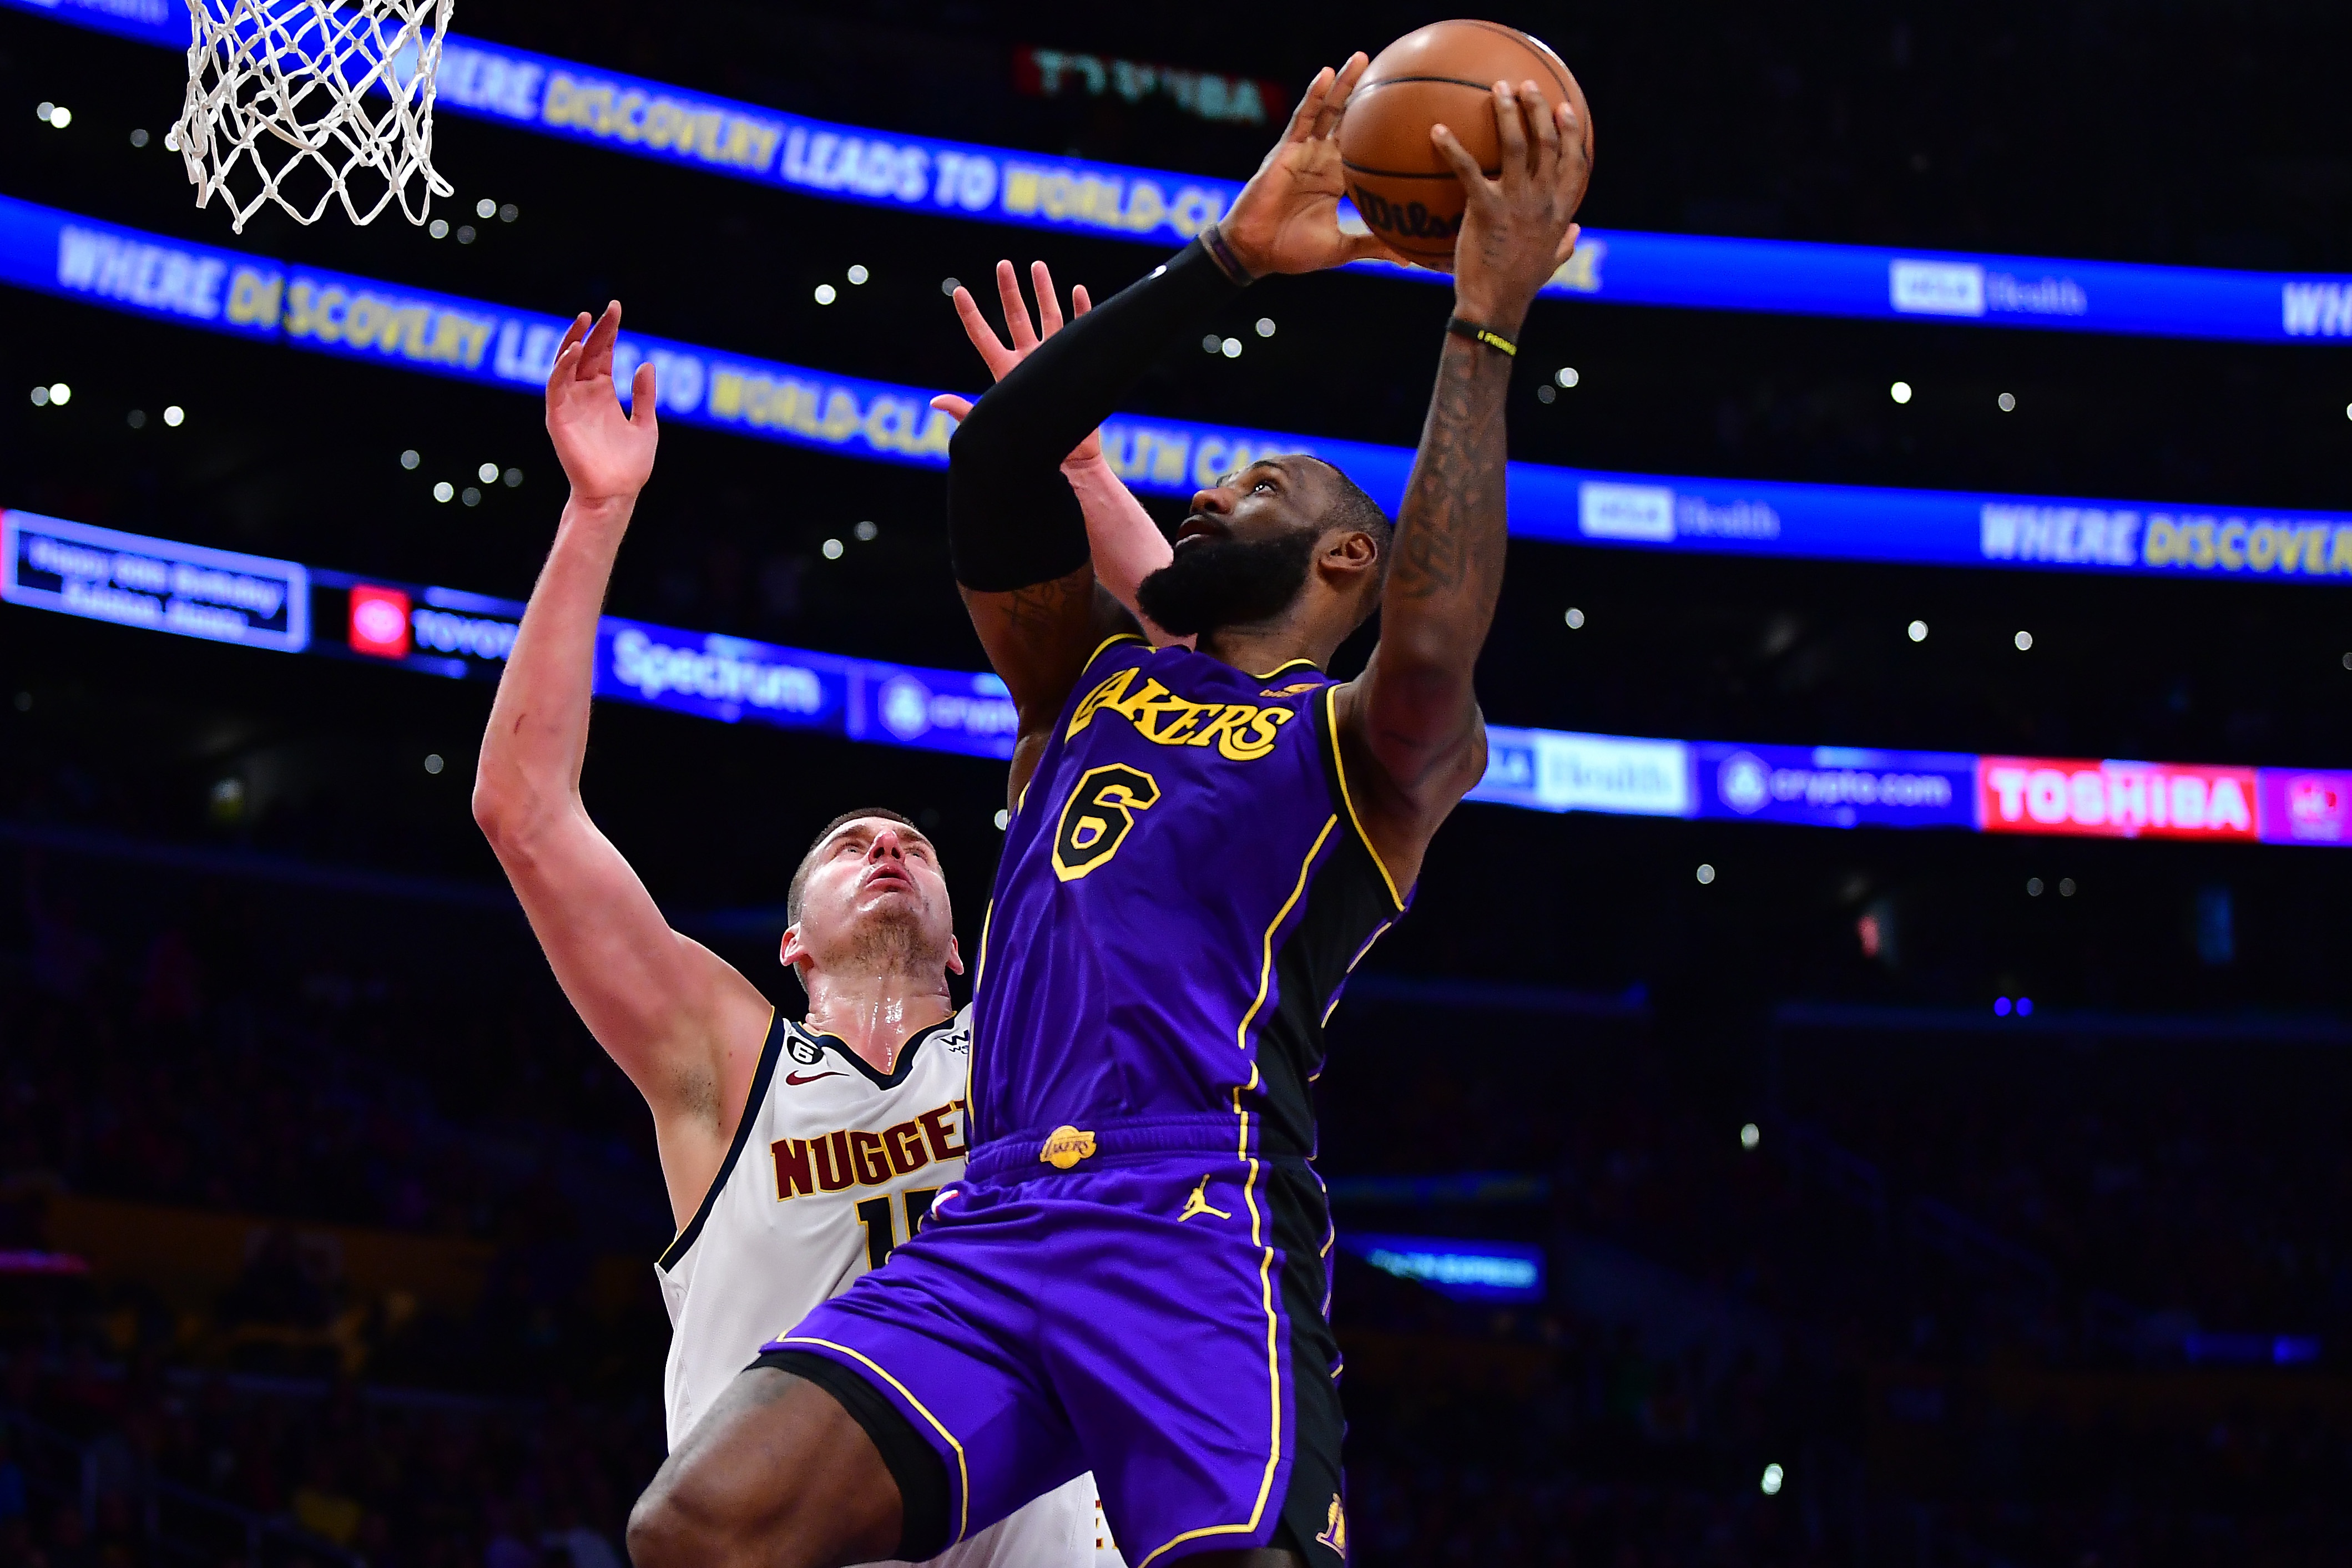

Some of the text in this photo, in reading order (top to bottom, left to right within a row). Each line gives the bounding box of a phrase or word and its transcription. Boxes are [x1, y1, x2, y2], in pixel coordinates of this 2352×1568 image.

[543, 73, 779, 169] DISCOVERY
[781, 127, 928, 199] LEADS
[936, 152, 998, 210] TO
[58, 227, 225, 318] WHERE
[226, 269, 493, 371] DISCOVERY
[1981, 504, 2141, 565] WHERE
[613, 629, 821, 716] Spectrum
[1051, 762, 1161, 882] 6
[1989, 768, 2251, 832] TOSHIBA
[793, 1042, 814, 1063] 6
[770, 1100, 966, 1202] NUGGE
